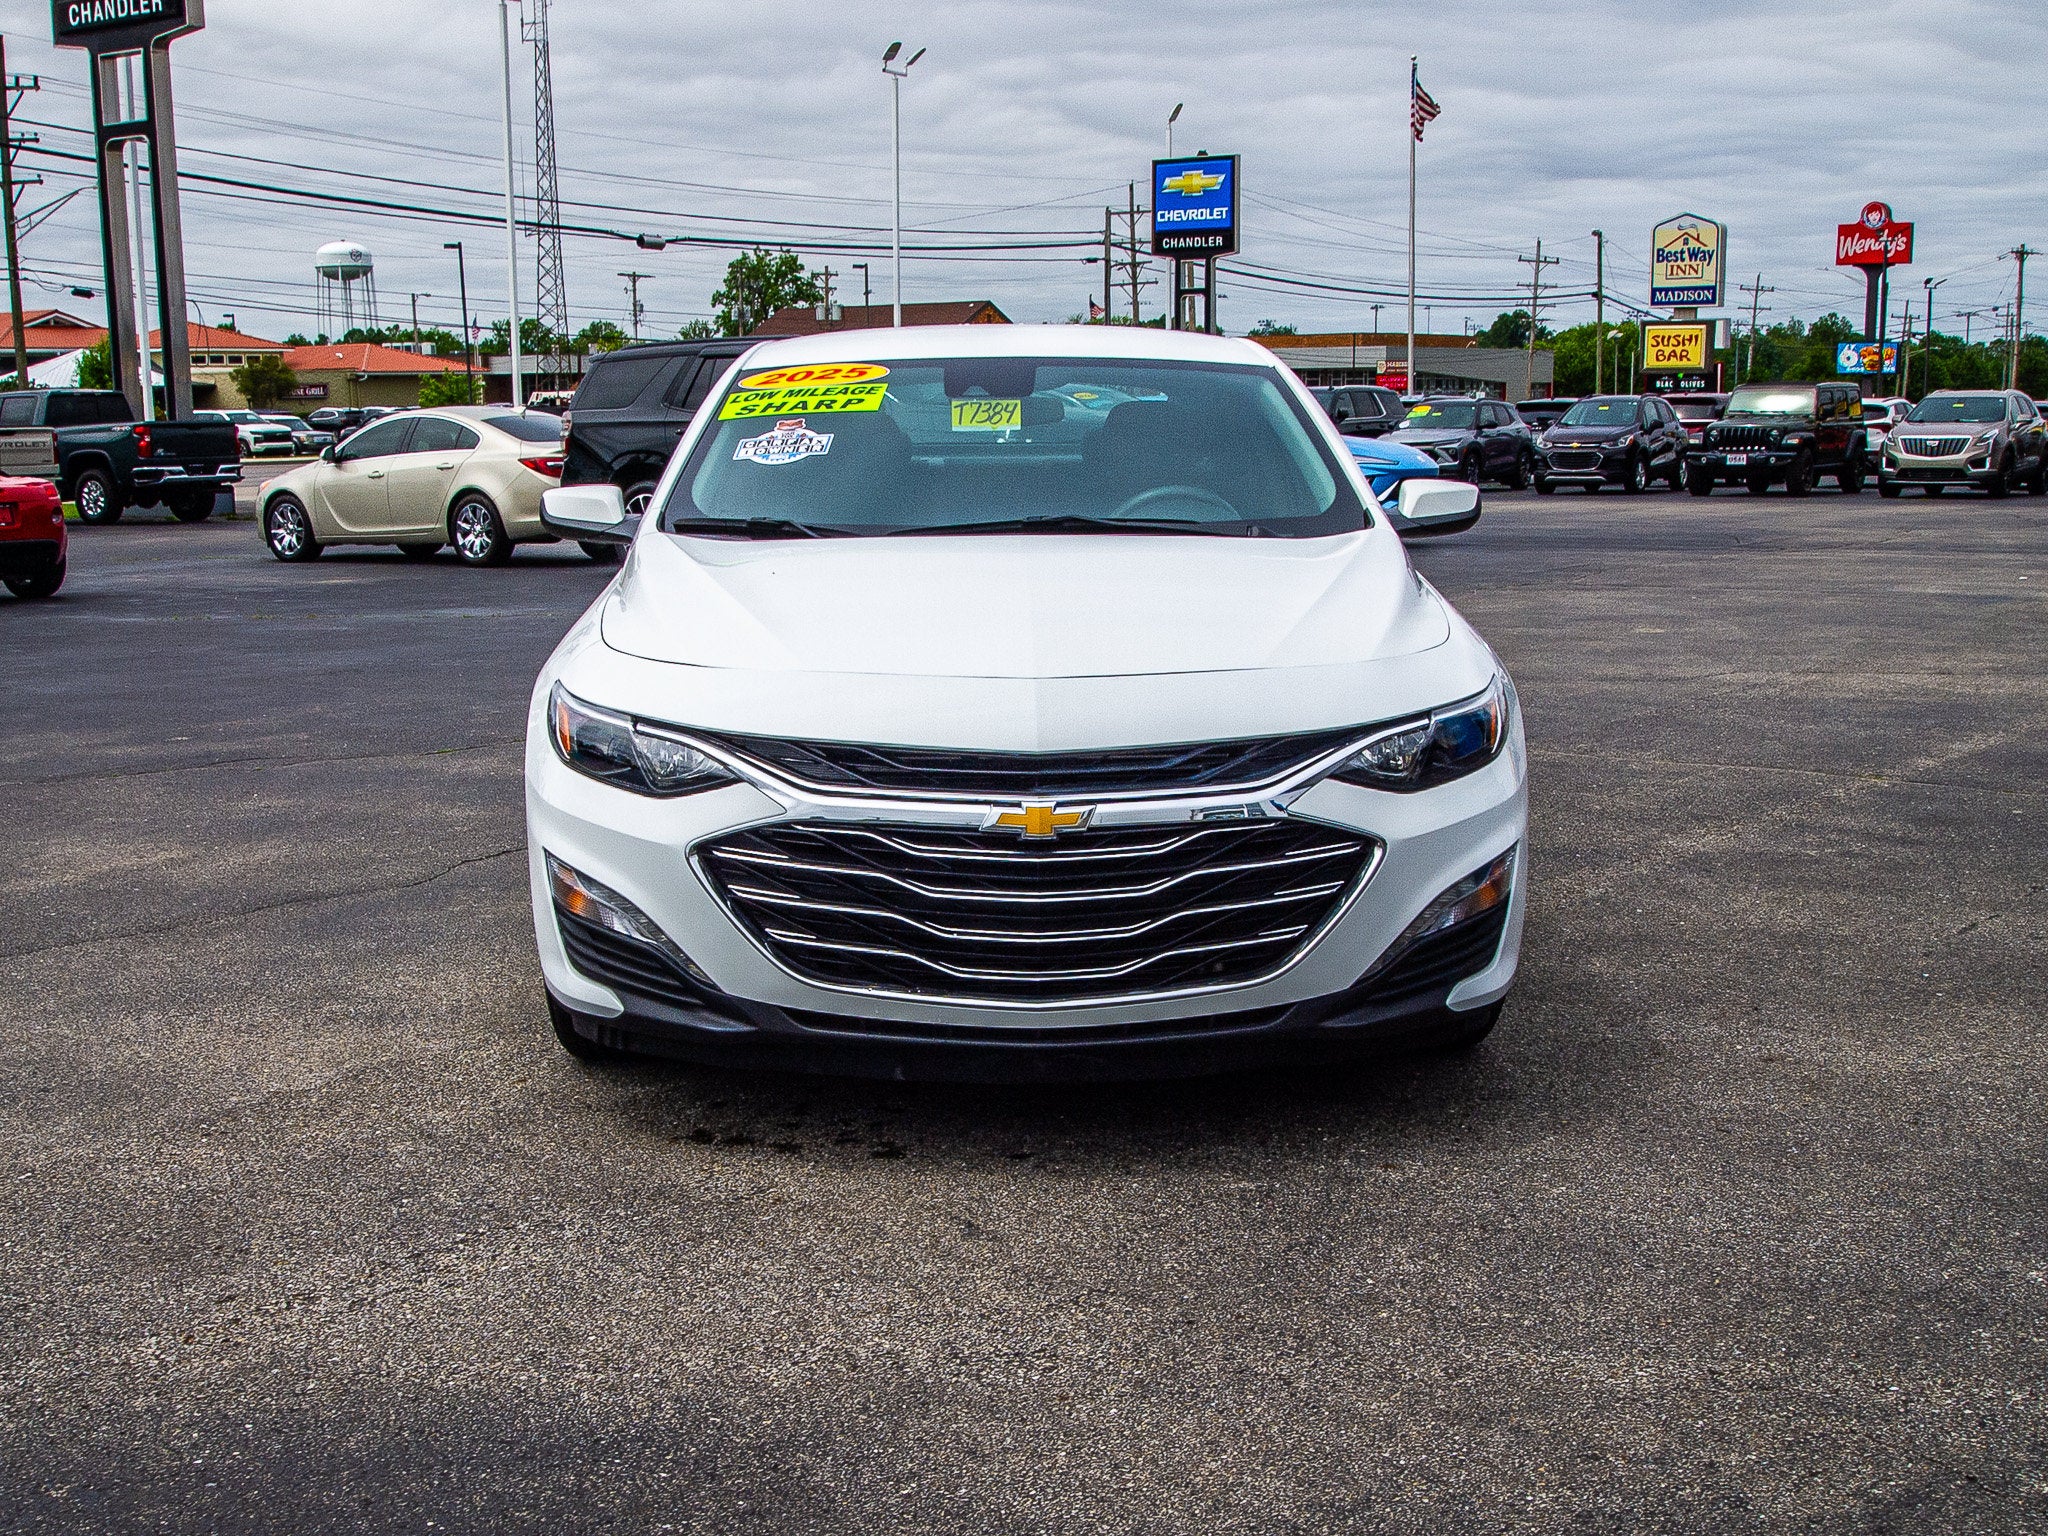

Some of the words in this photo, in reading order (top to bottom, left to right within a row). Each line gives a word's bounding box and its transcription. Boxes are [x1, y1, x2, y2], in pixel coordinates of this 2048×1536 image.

[68, 0, 163, 26] CHANDLER
[1157, 206, 1229, 222] CHEVROLET
[1162, 236, 1223, 248] CHANDLER
[1839, 229, 1907, 259] Wendy's
[1656, 247, 1686, 263] Best
[1687, 246, 1716, 267] Way
[1668, 263, 1700, 276] INN
[1654, 289, 1714, 302] MADISON
[1650, 334, 1699, 348] SUSHI
[1655, 349, 1691, 362] BAR
[756, 367, 873, 386] 2025
[1680, 380, 1705, 388] OLIVES
[730, 390, 782, 404] LOW
[782, 386, 883, 398] MILEAGE
[735, 398, 867, 416] SHARP
[953, 400, 1018, 425] T7384
[744, 438, 824, 449] CARFAX
[754, 444, 825, 454] OWNER
